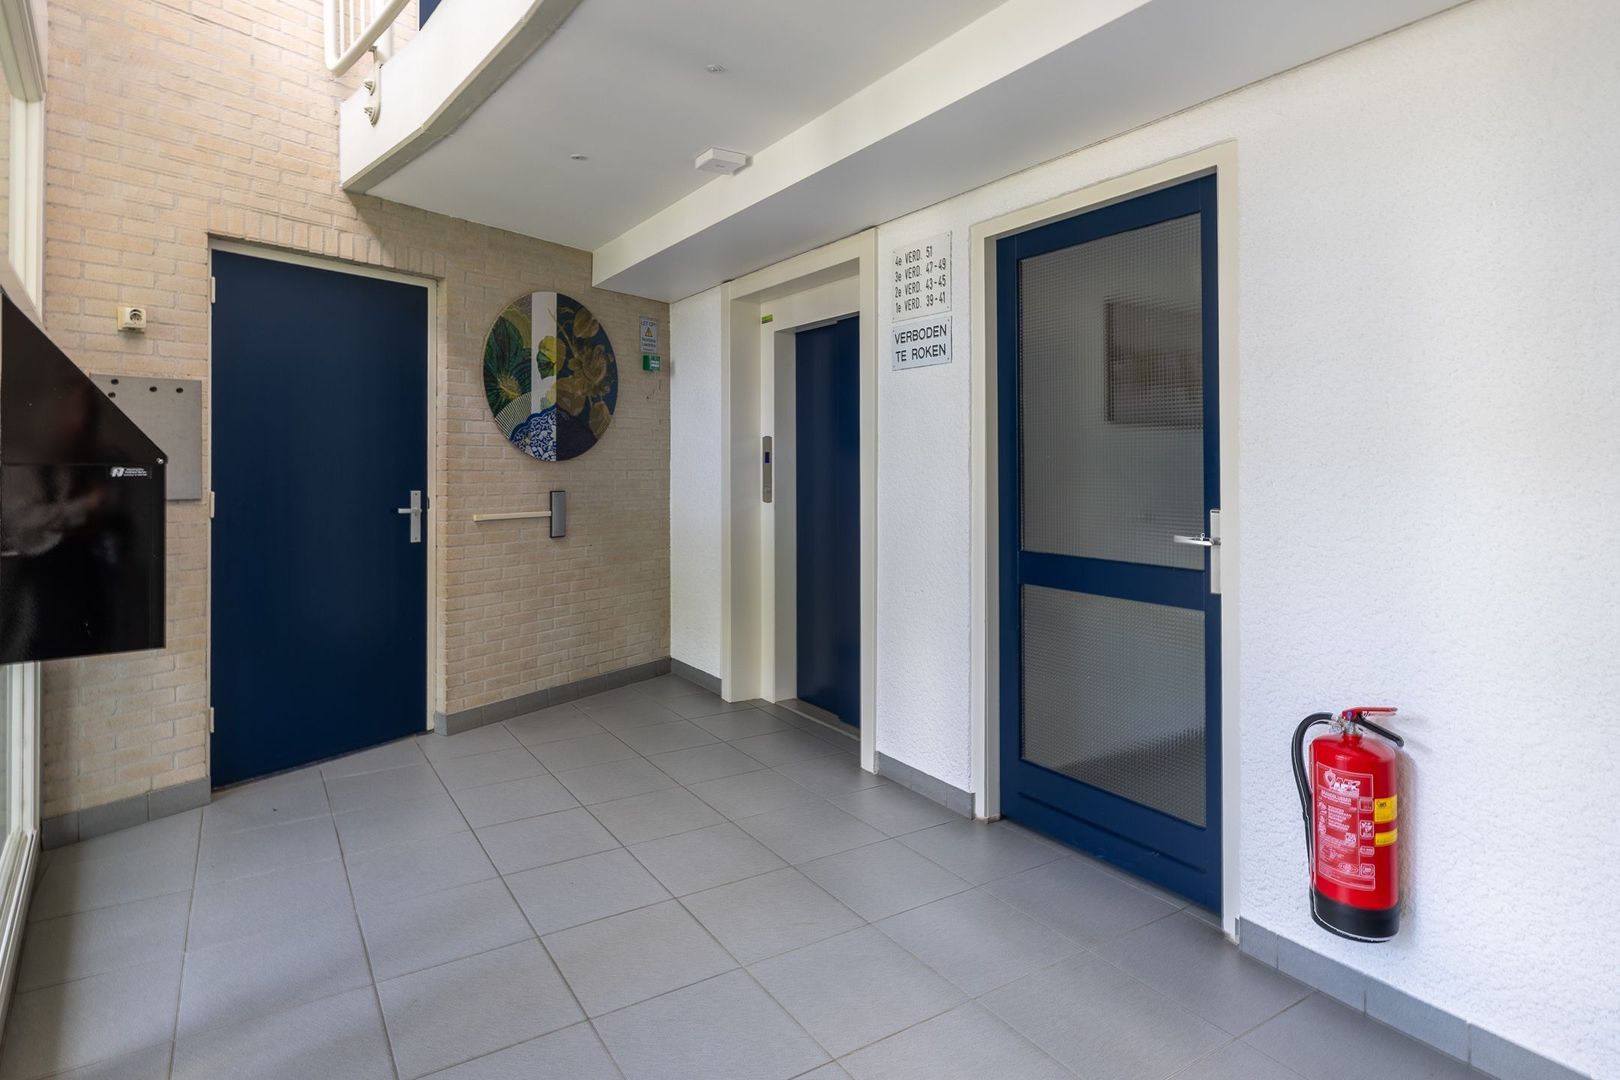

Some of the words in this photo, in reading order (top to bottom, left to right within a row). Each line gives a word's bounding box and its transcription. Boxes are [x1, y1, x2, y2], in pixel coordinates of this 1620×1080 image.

[895, 256, 902, 267] 4e
[905, 249, 923, 264] VERD.
[926, 245, 933, 258] 51
[895, 271, 902, 283] 3e
[904, 265, 923, 280] VERD.
[895, 286, 902, 298] 2e
[904, 281, 923, 295] VERD.
[904, 297, 922, 311] VERD.
[895, 323, 947, 344] VERBODEN
[895, 350, 907, 362] TE
[911, 343, 946, 360] ROKEN
